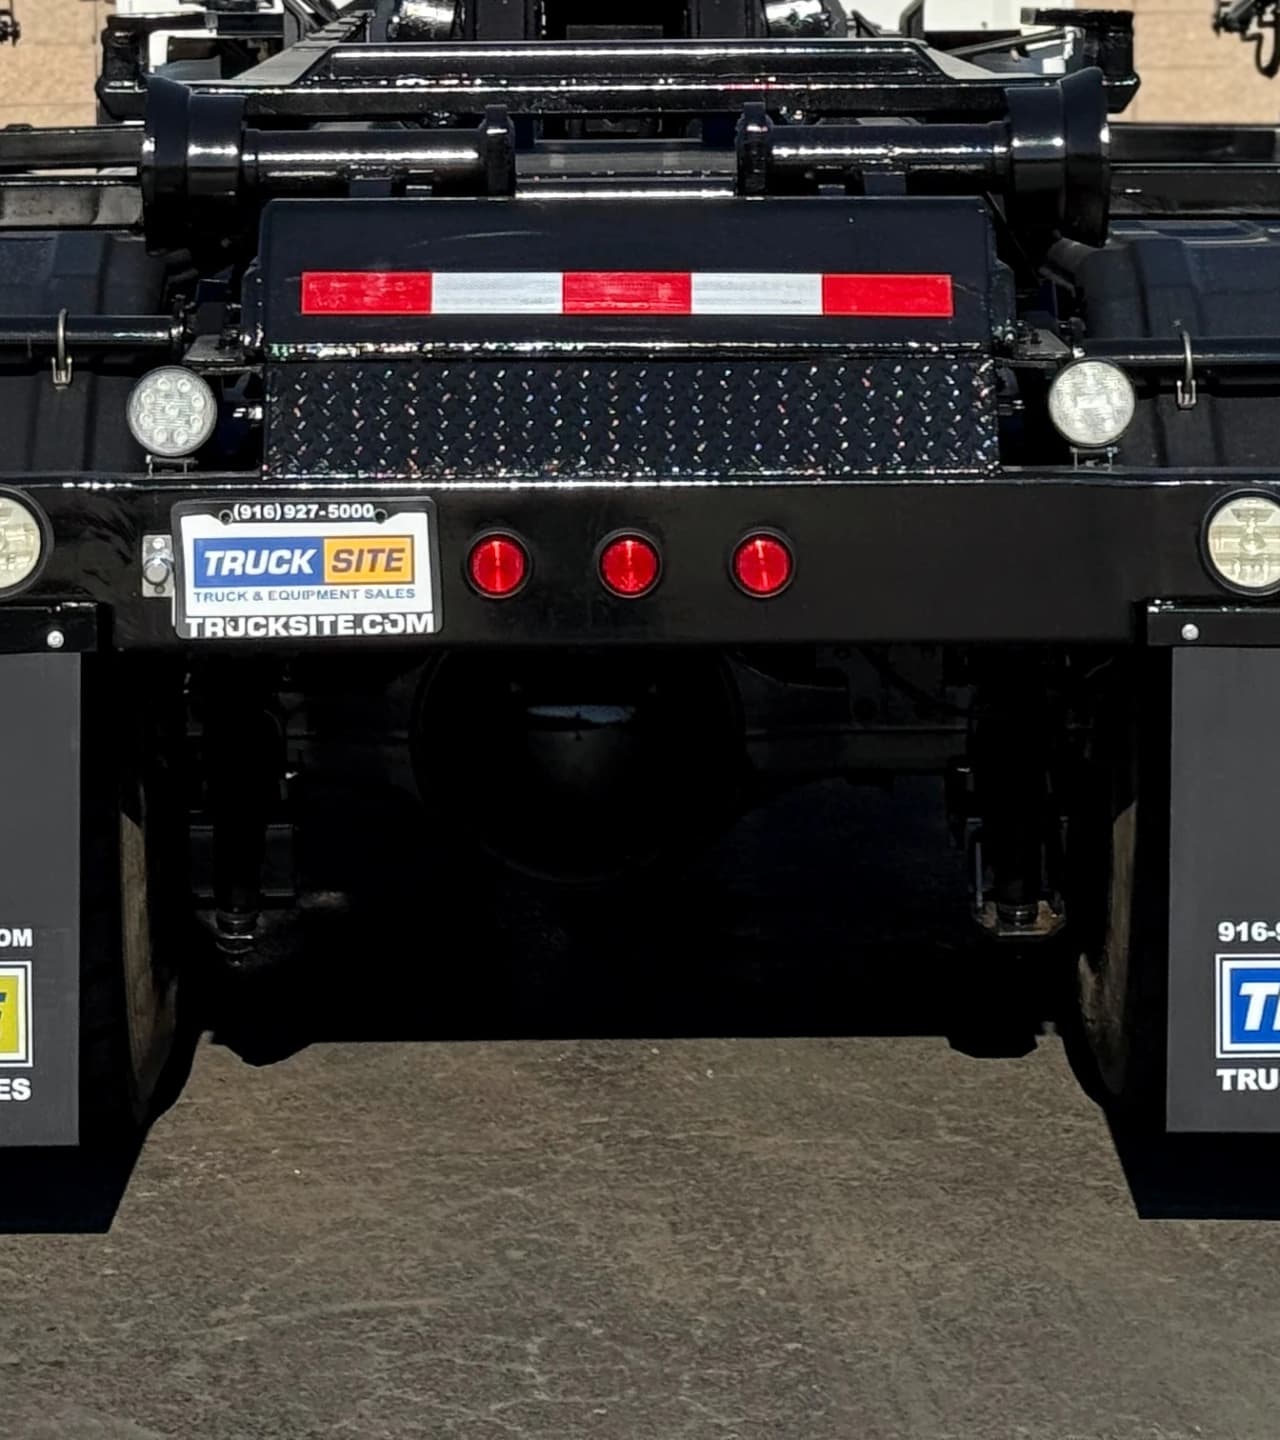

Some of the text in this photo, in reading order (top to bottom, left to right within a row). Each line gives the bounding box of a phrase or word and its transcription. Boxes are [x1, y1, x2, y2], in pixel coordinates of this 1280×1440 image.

[204, 548, 406, 577] TRUCK SITE
[194, 588, 415, 602] TRUCK & EQUIPMENT SALES
[185, 613, 434, 638] TRUCKSITE.COM
